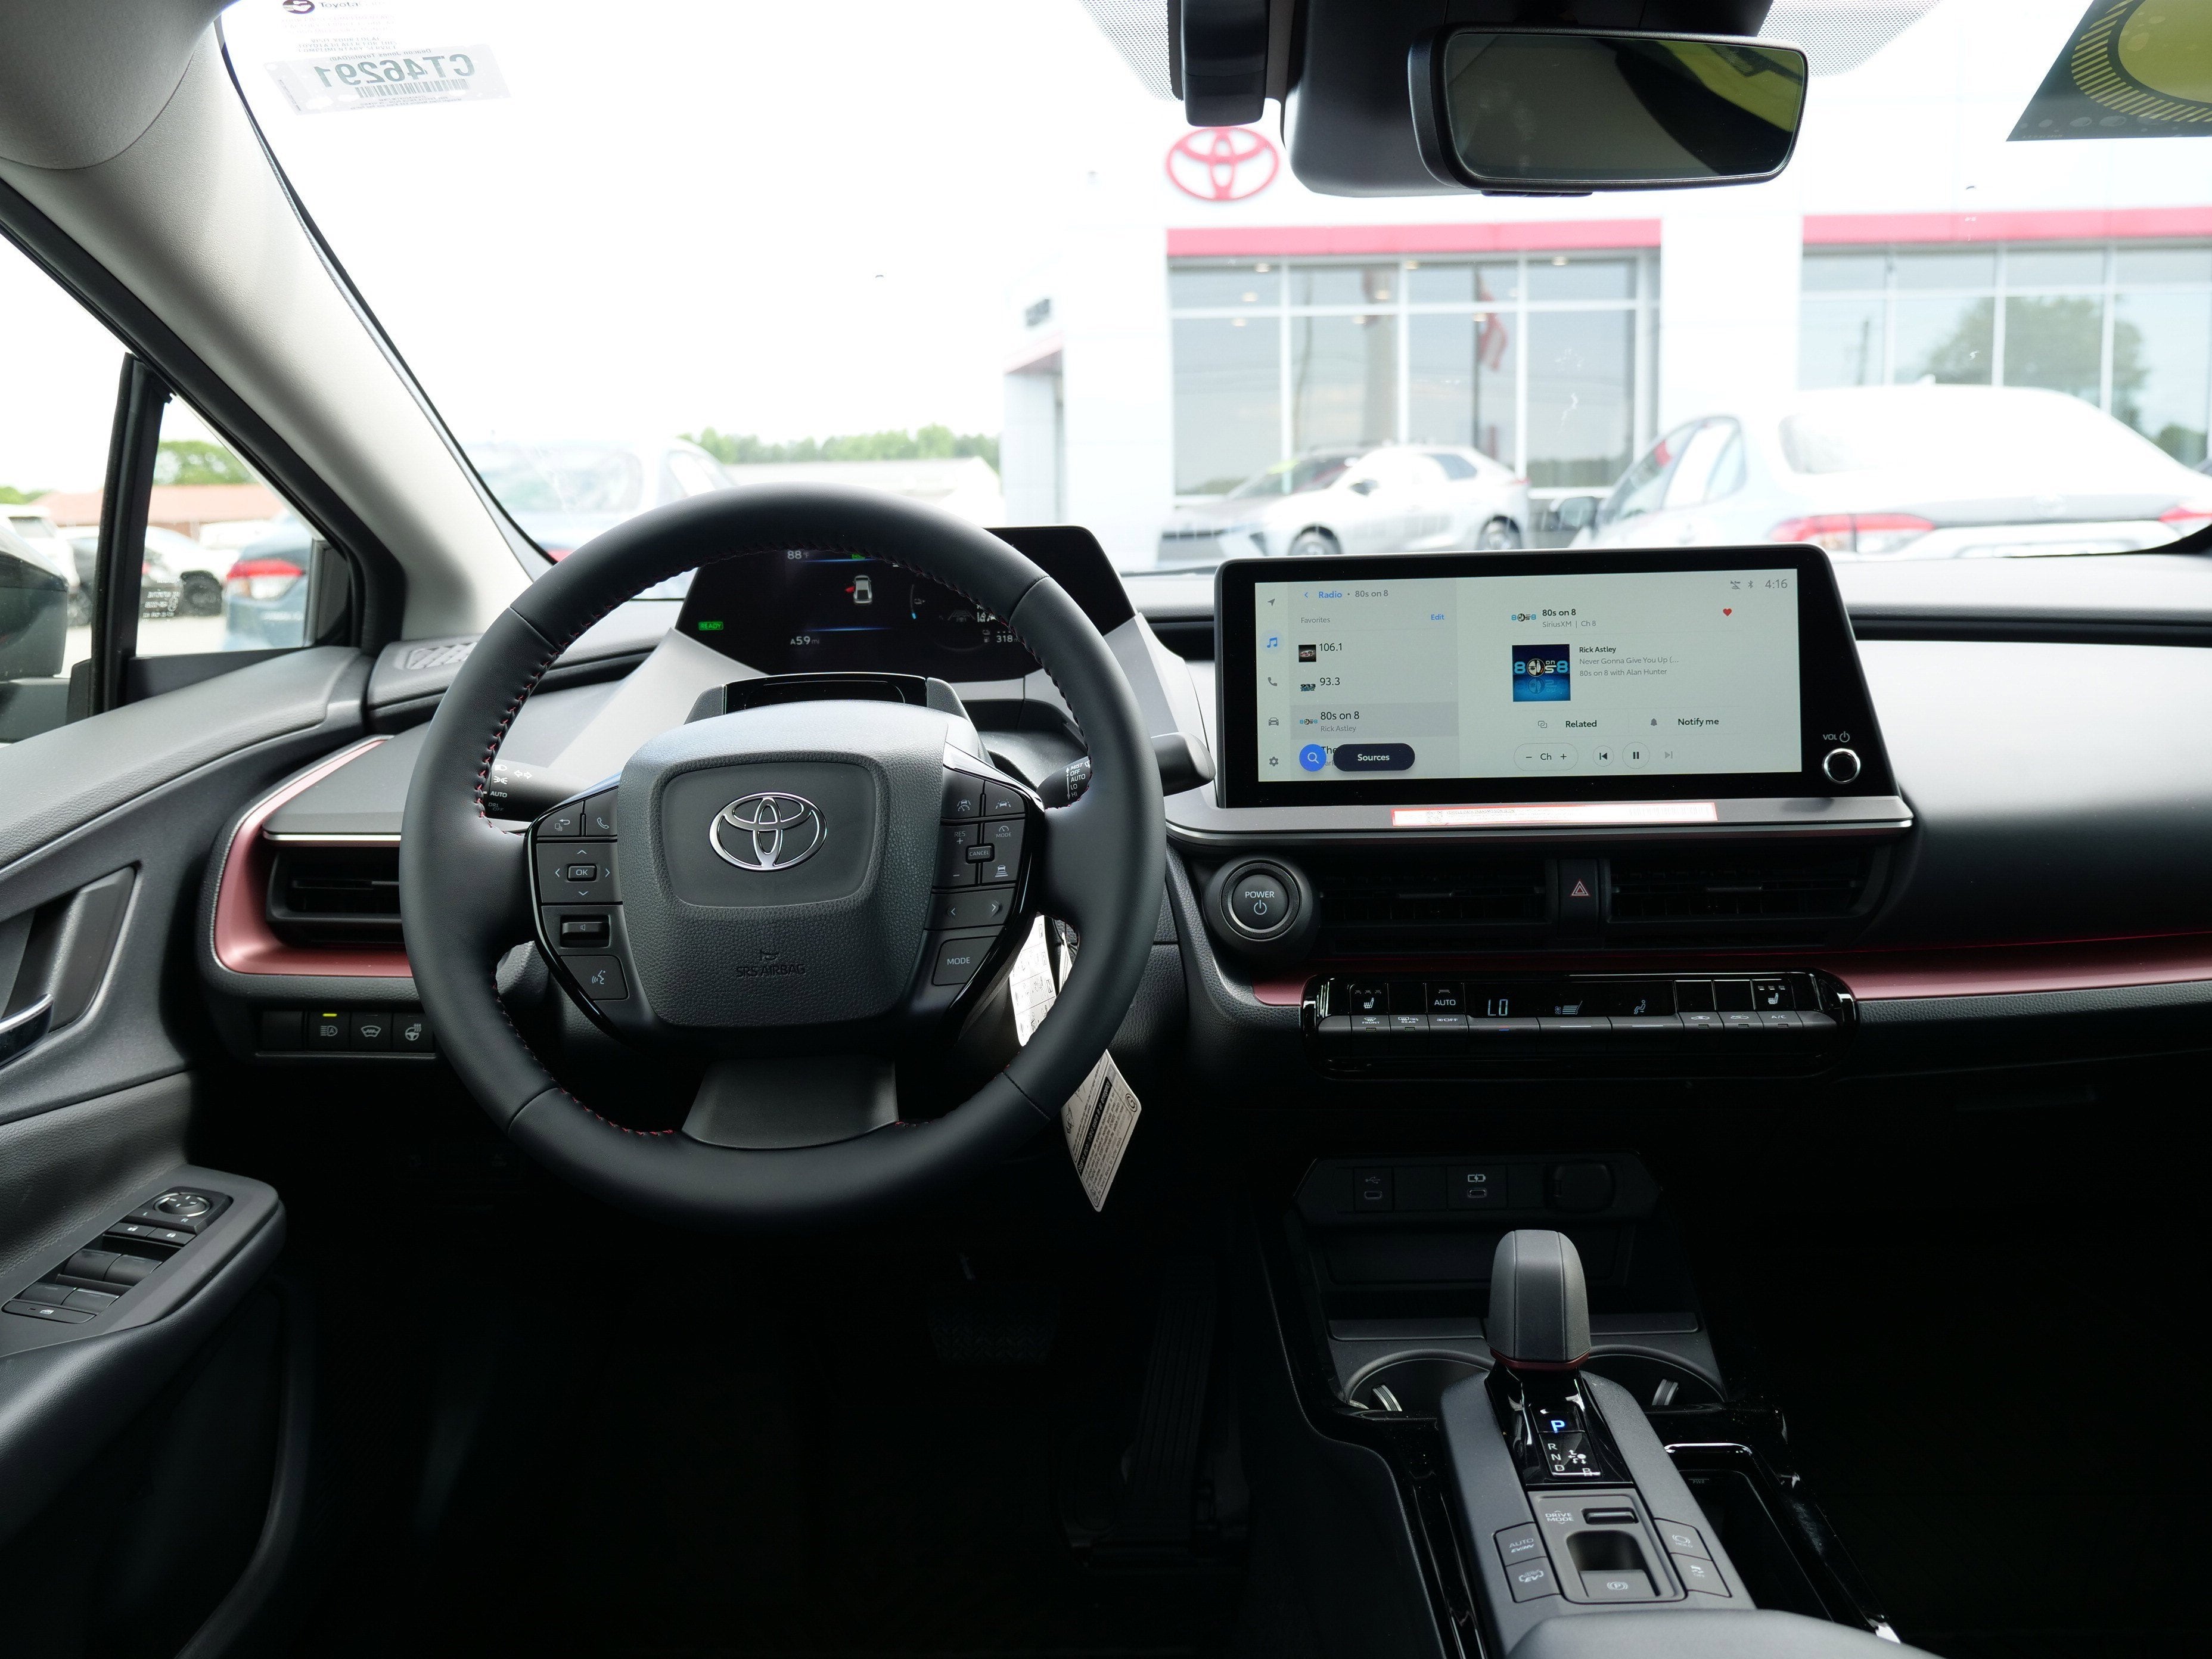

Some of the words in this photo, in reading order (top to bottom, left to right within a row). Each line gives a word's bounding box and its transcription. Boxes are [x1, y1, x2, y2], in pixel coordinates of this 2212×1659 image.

[1764, 579, 1788, 589] 4:16
[1318, 590, 1343, 599] Radio
[1354, 589, 1369, 598] 80s
[1542, 608, 1557, 617] 80s
[1300, 616, 1331, 624] Favorites
[996, 635, 1013, 643] 318
[1319, 643, 1343, 651] 106.1
[1595, 645, 1617, 654] Astley
[1657, 656, 1667, 664] Up
[1319, 677, 1340, 686] 93.3
[1320, 712, 1337, 720] 80s
[1353, 711, 1360, 720] 8
[1565, 719, 1597, 728] Related
[1677, 717, 1703, 727] Notify
[1335, 725, 1356, 733] Astley
[1357, 753, 1390, 762] Sources
[1540, 752, 1552, 760] Ch
[1070, 773, 1086, 783] AUTO
[946, 956, 971, 965] MODE
[736, 966, 757, 977] SRS
[759, 964, 806, 977] AIRBAG
[1551, 1420, 1565, 1433] P
[1509, 1537, 1534, 1548] AUTO
